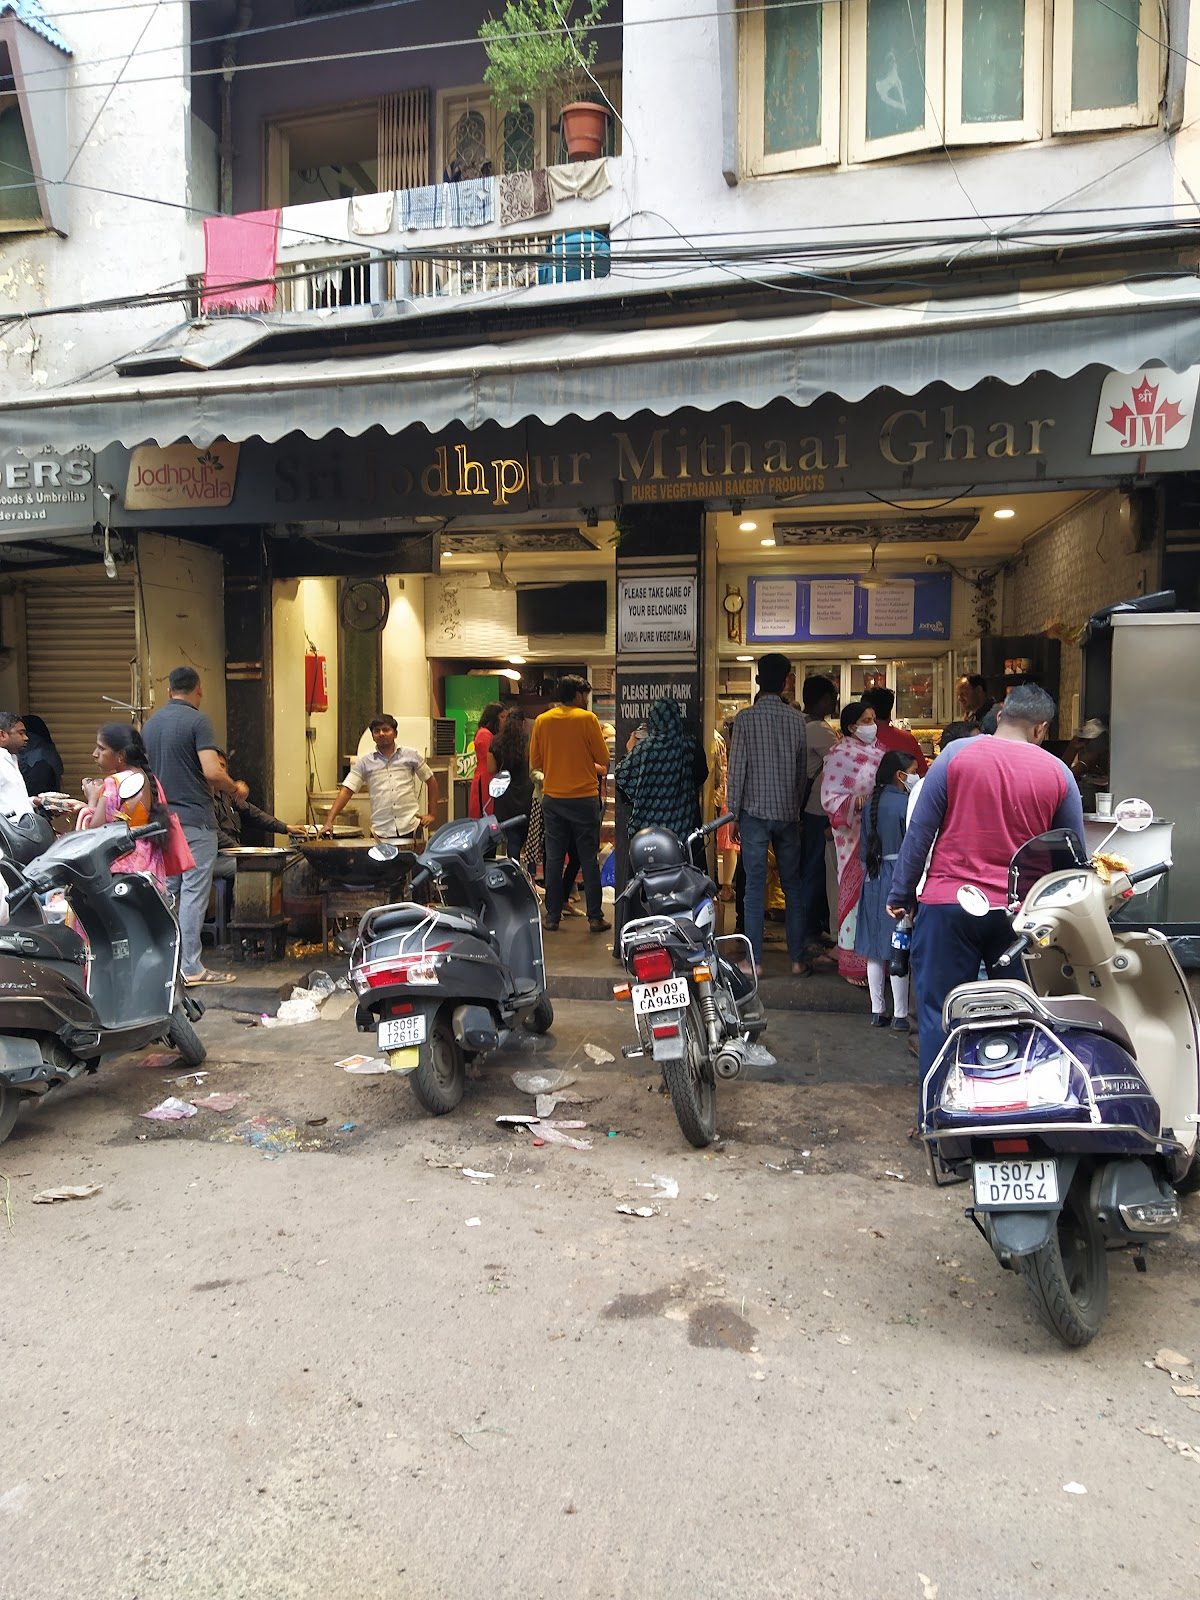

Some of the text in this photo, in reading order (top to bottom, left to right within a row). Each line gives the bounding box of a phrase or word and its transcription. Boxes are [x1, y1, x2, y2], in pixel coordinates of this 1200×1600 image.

[1138, 389, 1152, 403] श्री
[1120, 416, 1165, 448] JM
[359, 444, 592, 506] Jodhpur
[612, 415, 849, 482] Mithaai
[879, 404, 1056, 466] Ghar
[0, 460, 92, 488] ERS
[134, 463, 214, 488] Jodhpur
[631, 475, 825, 501] PURE VEGETARIAN BAKERY PRODUCTS
[27, 493, 34, 505] &
[36, 490, 87, 503] Umbrellas
[624, 586, 692, 600] PLEASE TAKE CARE OF
[628, 604, 687, 617] YOUR BELONGINGS
[624, 630, 691, 643] 100% PURE VEGETARIAN
[622, 683, 692, 700] PLEASE DON'T PARK
[620, 703, 640, 719] YOUR
[643, 982, 679, 999] AP 09
[640, 993, 687, 1011] CA9458
[387, 1017, 420, 1033] TS09F
[387, 1029, 420, 1044] T2616
[990, 1183, 1047, 1202] D7054
